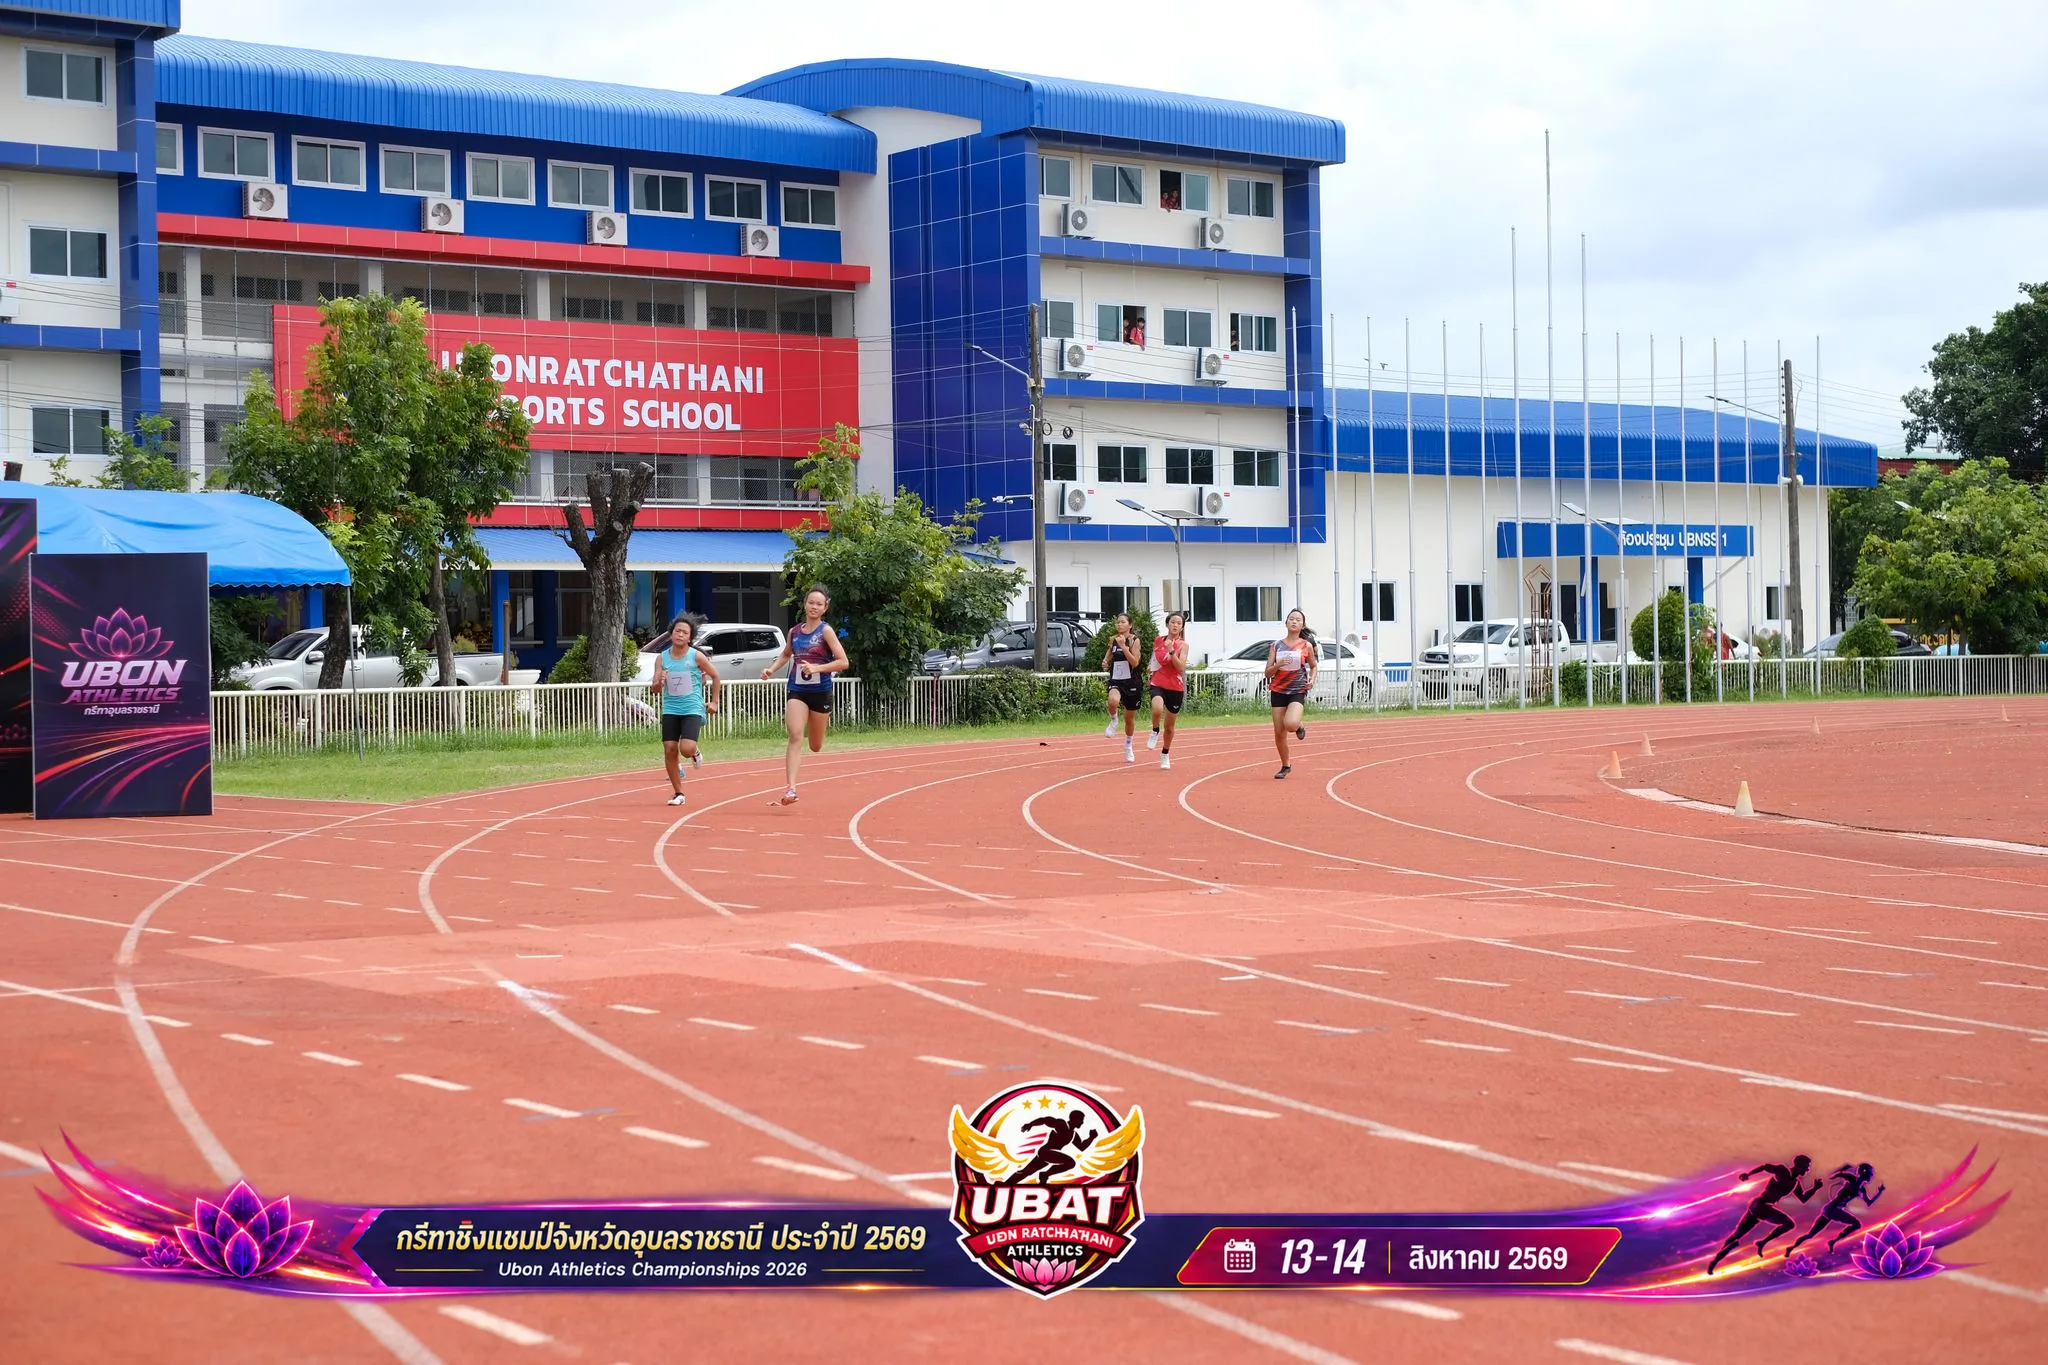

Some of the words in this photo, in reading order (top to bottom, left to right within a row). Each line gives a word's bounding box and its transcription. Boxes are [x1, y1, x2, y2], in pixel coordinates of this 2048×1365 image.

[442, 350, 764, 394] UONRATCHATHANI
[486, 394, 605, 427] ORTS
[622, 399, 741, 431] SCHOOL
[1721, 532, 1728, 547] 1
[61, 659, 188, 687] UBON
[65, 687, 182, 702] ATHLETICS
[673, 677, 683, 692] 7
